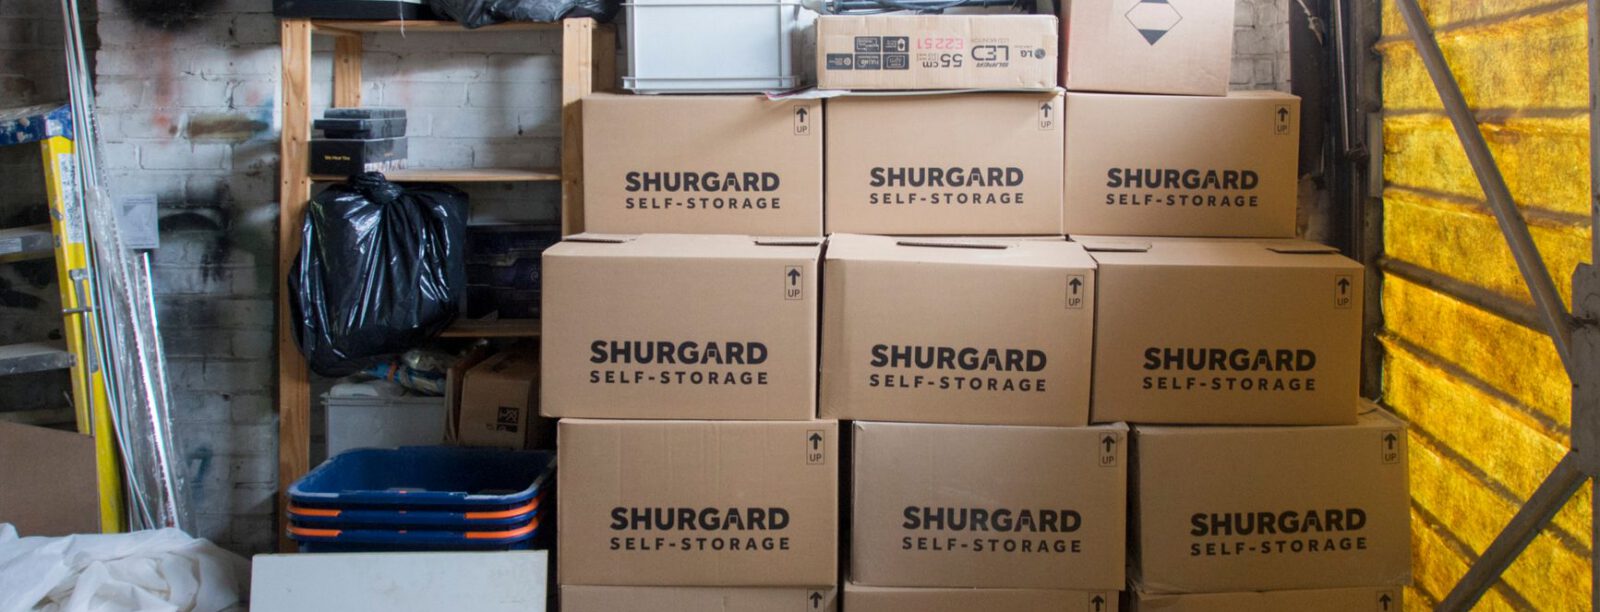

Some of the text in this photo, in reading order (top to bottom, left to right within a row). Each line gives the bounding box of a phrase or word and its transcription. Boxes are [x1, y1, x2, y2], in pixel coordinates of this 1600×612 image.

[917, 38, 963, 50] E2251
[971, 45, 1009, 61] LED
[940, 53, 963, 68] 55
[797, 126, 808, 134] UP
[1278, 125, 1288, 133] UP
[625, 172, 779, 192] SHURGARD
[870, 167, 1023, 187] SHURGARD
[1107, 168, 1259, 190] SHURGARD
[626, 198, 780, 209] SELF-STORAGE
[870, 193, 1023, 205] SELF-STORAGE
[1106, 194, 1259, 208] SELF-STORAGE
[788, 289, 800, 297] UP
[1069, 298, 1081, 306] UP
[1338, 298, 1349, 306] UP
[590, 340, 767, 364] SHURGARD
[871, 345, 1047, 371] SHURGARD
[1144, 348, 1316, 371] SHURGARD
[590, 371, 767, 384] SELF-STORAGE
[870, 374, 1046, 392] SELF-STORAGE
[1143, 377, 1316, 391] SELF-STORAGE
[810, 454, 822, 462] UP
[1103, 456, 1114, 464] UP
[1385, 453, 1396, 461] UP
[610, 507, 789, 530] SHURGARD
[903, 506, 1081, 532] SHURGARD
[1191, 509, 1366, 536] SHURGARD
[611, 537, 789, 551] SELF-STORAGE
[903, 537, 1081, 553] SELF-STORAGE
[1191, 539, 1366, 557] SELF-STORAGE
